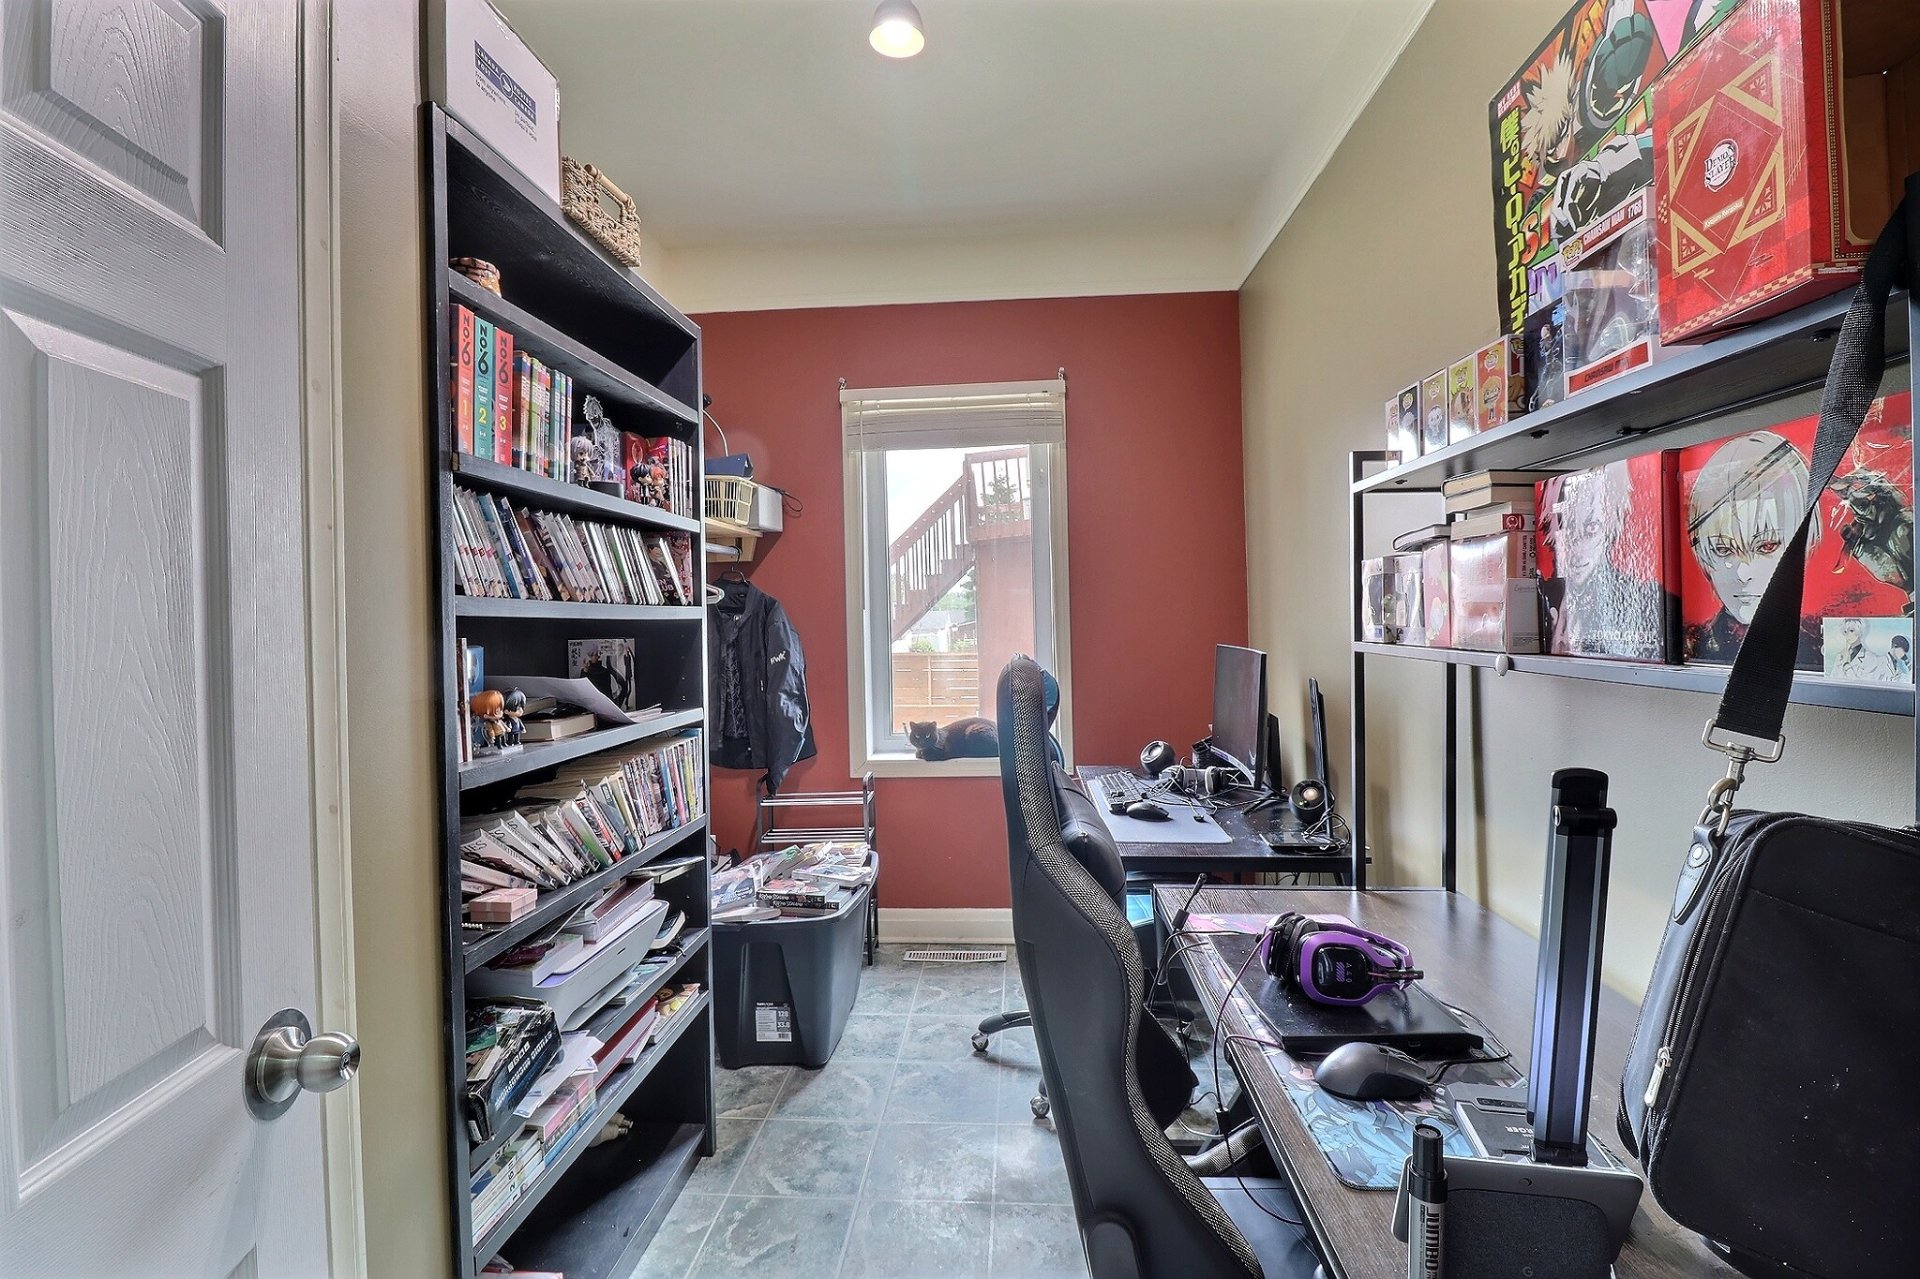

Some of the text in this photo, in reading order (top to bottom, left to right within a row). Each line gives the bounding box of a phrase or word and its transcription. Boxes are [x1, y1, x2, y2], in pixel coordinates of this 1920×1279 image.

[1705, 145, 1735, 172] DEMON
[1705, 156, 1736, 184] SLAYER
[478, 407, 487, 425] 2
[499, 415, 507, 431] 3
[1425, 1206, 1440, 1270] JUMBO
[1522, 1266, 1534, 1277] G
